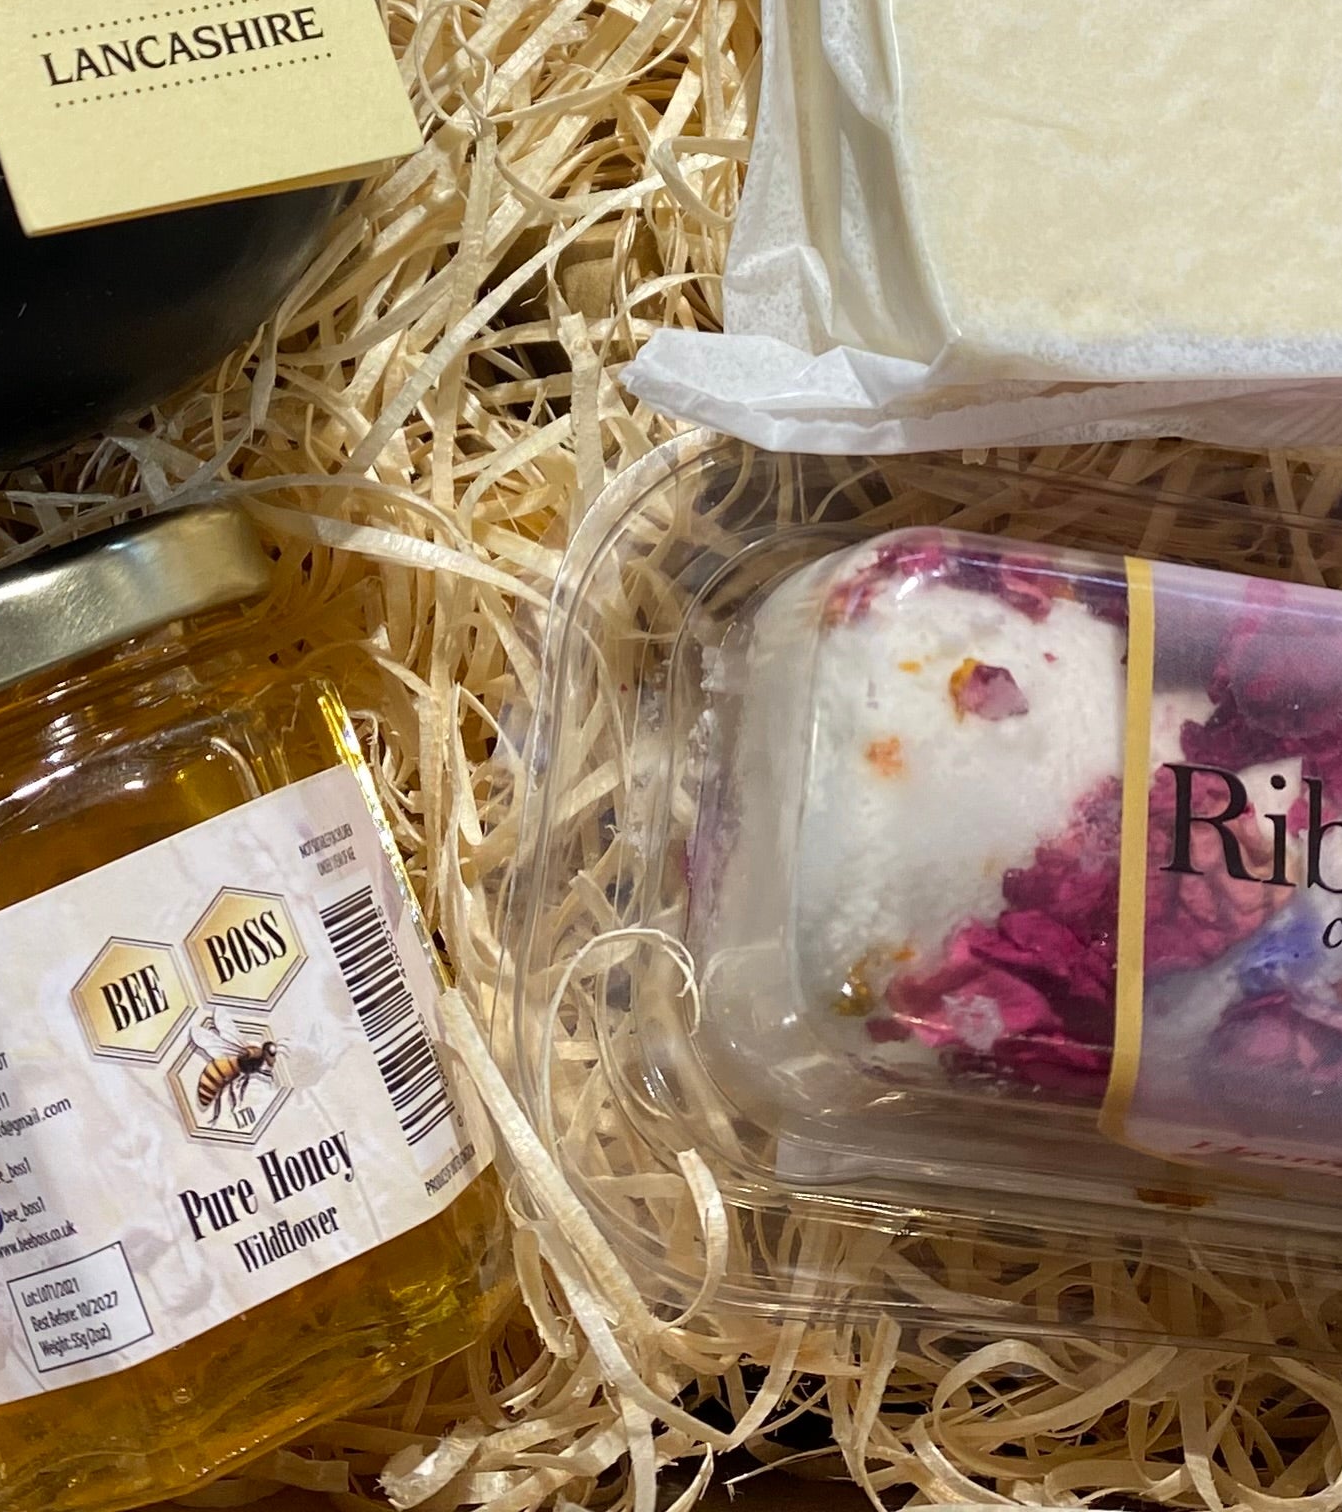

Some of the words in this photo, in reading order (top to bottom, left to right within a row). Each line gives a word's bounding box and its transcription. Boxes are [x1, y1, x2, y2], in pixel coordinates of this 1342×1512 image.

[40, 7, 324, 86] LANCASHIRE
[100, 964, 170, 1033] BEE
[204, 910, 287, 985] BOSS
[232, 1106, 257, 1130] LTD
[2, 1197, 46, 1223] bee_boss1
[177, 1178, 259, 1242] Pure
[256, 1130, 355, 1204] Honey
[234, 1206, 340, 1273] Wildflower
[30, 1313, 49, 1332] Best
[77, 1291, 119, 1321] 10/2027
